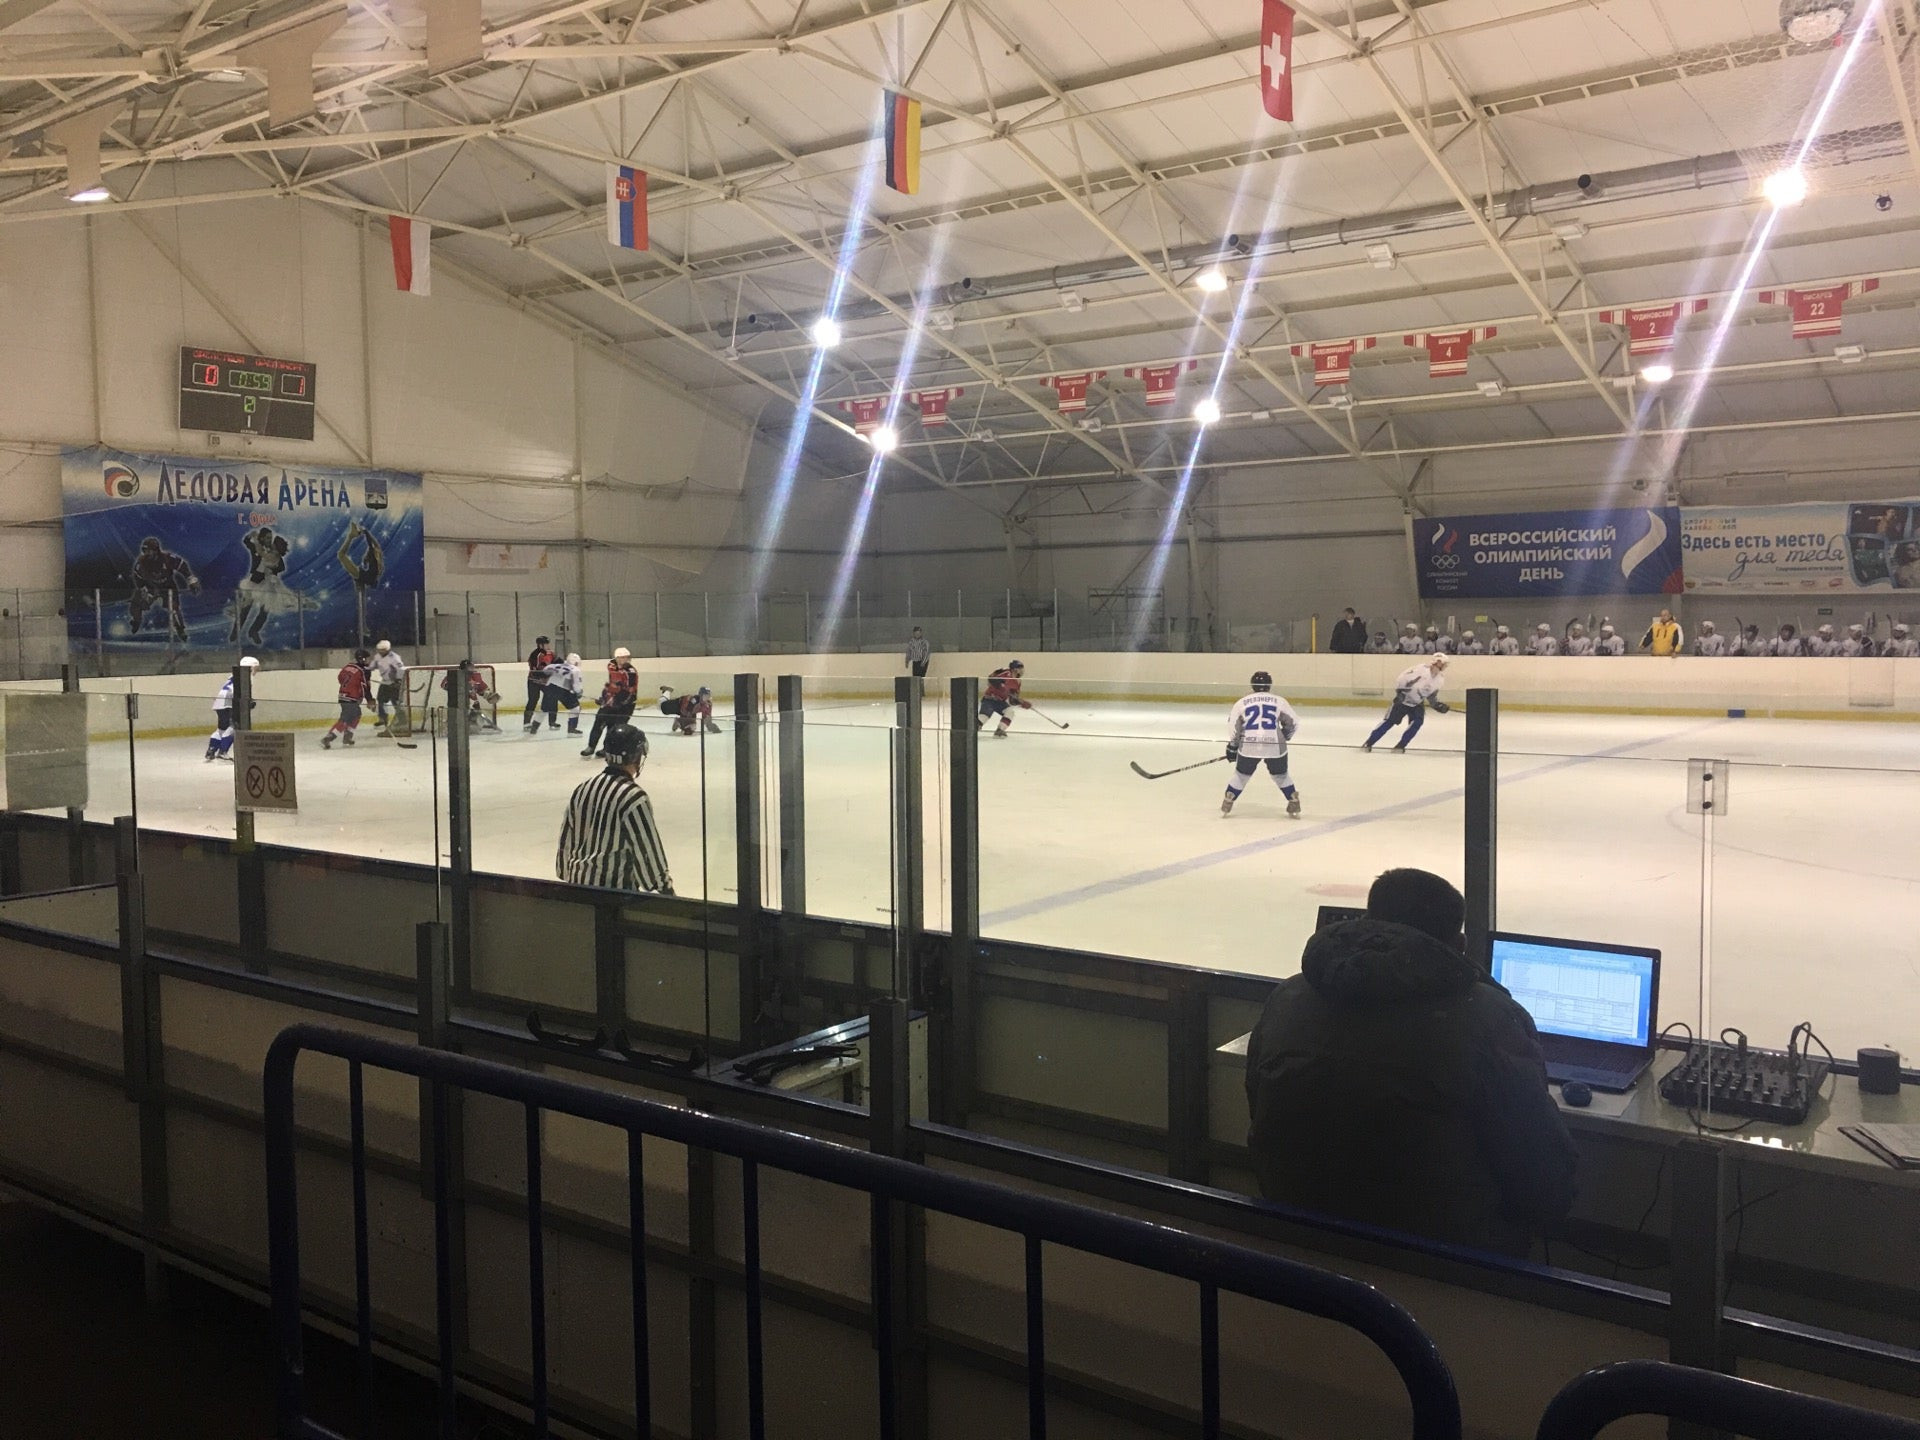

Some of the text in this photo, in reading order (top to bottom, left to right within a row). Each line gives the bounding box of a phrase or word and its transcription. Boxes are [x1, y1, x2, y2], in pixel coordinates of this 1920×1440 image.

[1632, 309, 1673, 321] ЧУДИНОВСКИЙ
[1810, 303, 1825, 316] 22
[1649, 323, 1656, 334] 2
[1446, 346, 1452, 358] 4
[205, 365, 218, 385] 0
[1469, 526, 1616, 546] ВСЕРОССИЙСКИЙ
[1682, 533, 1825, 551] Здесь есть место
[1474, 545, 1611, 564] ОЛИМПИЙСКИЙ
[1727, 534, 1846, 582] для тебя
[1519, 567, 1564, 583] ДЕНЬ
[1245, 704, 1277, 730] 25
